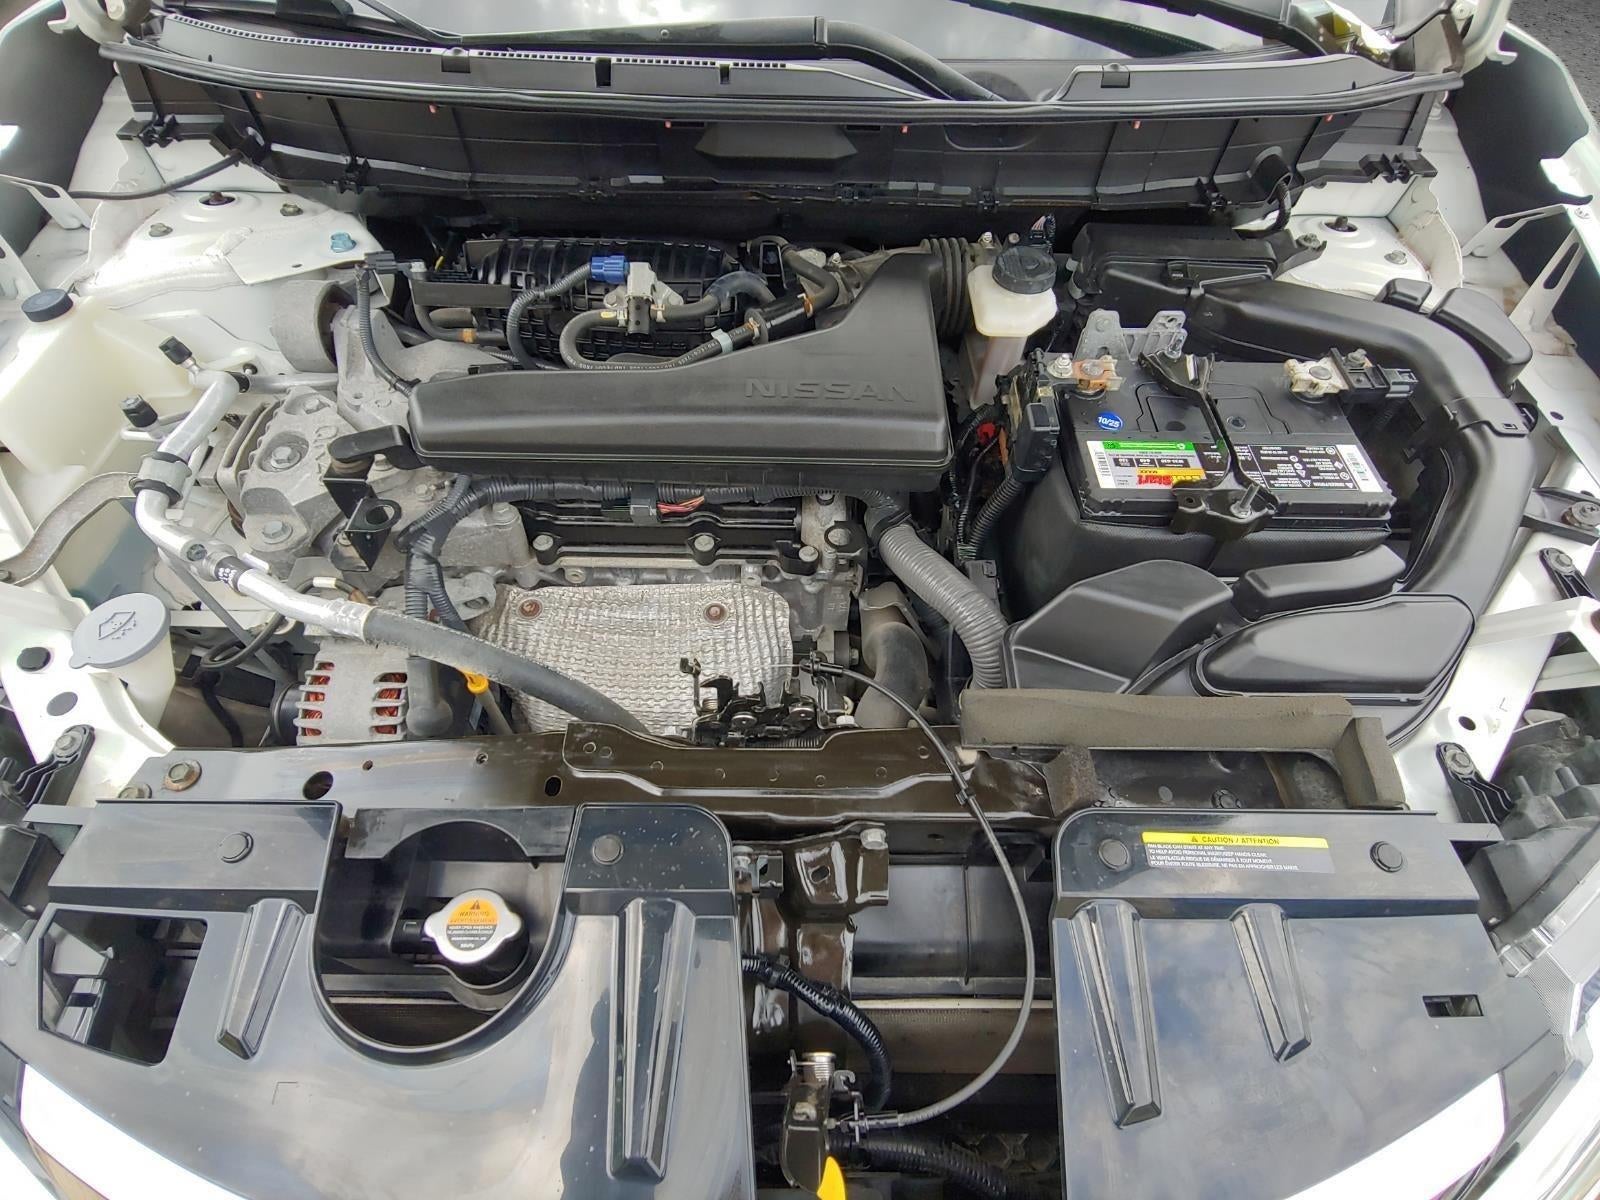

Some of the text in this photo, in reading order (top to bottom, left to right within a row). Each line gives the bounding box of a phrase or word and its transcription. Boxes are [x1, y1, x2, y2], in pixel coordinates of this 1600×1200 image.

[745, 378, 914, 402] NISSAN
[1098, 416, 1120, 428] 10/25
[1202, 836, 1233, 844] CAUTION
[1242, 837, 1280, 845] ATTENTION
